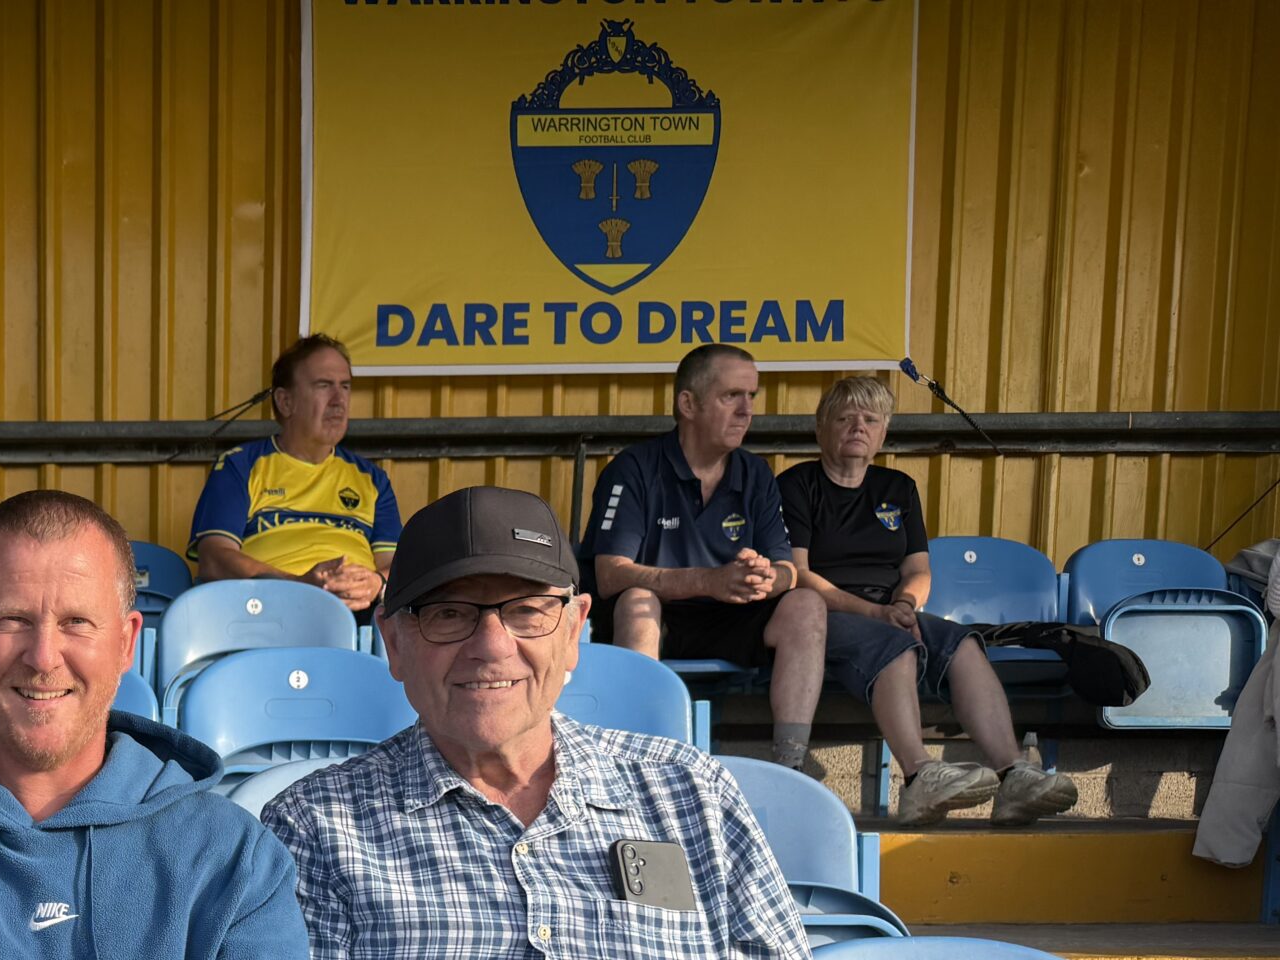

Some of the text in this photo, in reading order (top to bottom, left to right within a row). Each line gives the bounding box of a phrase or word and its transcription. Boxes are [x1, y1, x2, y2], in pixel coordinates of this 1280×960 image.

[532, 116, 700, 132] WARRINGTON TOWN
[579, 135, 652, 144] FOOTBALL CLUB
[375, 300, 845, 347] DARE TO DREAM
[35, 902, 70, 918] NIKE
